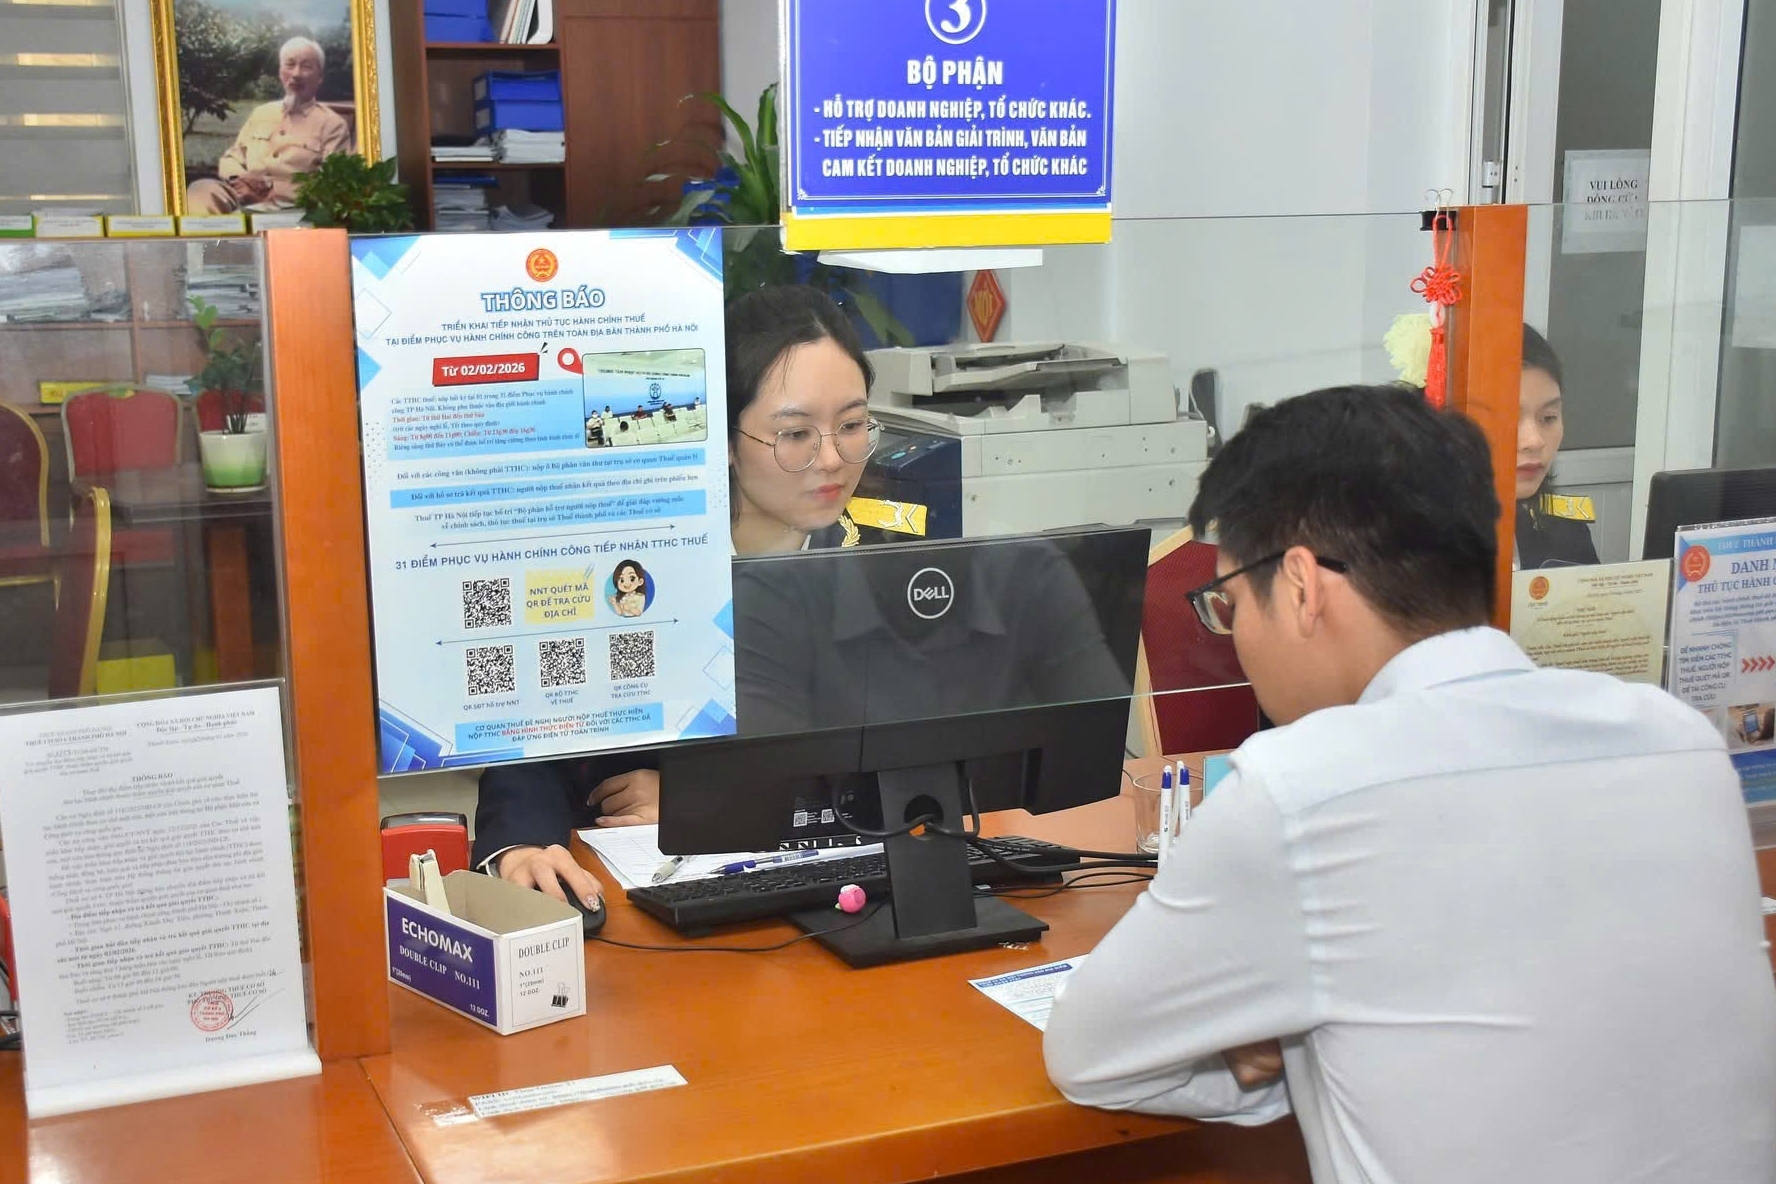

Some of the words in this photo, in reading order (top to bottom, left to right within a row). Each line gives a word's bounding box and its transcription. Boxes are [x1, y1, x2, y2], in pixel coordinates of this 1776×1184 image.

[940, 0, 971, 33] 3
[907, 56, 936, 89] BỘ
[942, 56, 1003, 90] PHẬN
[823, 94, 843, 118] HỖ
[846, 98, 874, 122] TRỢ
[877, 100, 926, 118] DOANH
[929, 97, 985, 122] NGHIỆP,
[988, 94, 1006, 118] TỔ
[1009, 97, 1045, 118] CHỨC
[1049, 98, 1092, 118] KHÁC.
[823, 124, 852, 148] TIẾP
[856, 126, 893, 150] NHẬN
[896, 126, 921, 147] VĂN
[926, 125, 951, 147] BẢN
[955, 125, 982, 147] GIẢI
[985, 126, 1028, 149] TRÌNH,
[1031, 126, 1056, 147] VĂN
[1060, 125, 1086, 147] BẢN
[822, 159, 854, 177] CAM
[857, 153, 882, 176] KẾT
[886, 158, 933, 176] DOANH
[936, 155, 989, 180] NGHIỆP,
[992, 152, 1010, 176] TỔ
[1012, 154, 1048, 176] CHỨC
[1052, 154, 1087, 175] KHÁC
[1590, 181, 1606, 190] VUI
[1610, 177, 1637, 189] LÒNG
[480, 287, 557, 313] THÔNG
[561, 285, 606, 309] BÁO
[442, 320, 466, 331] TRIỂN
[469, 322, 488, 330] KHAI
[490, 318, 508, 329] TIẾP
[511, 318, 533, 329] NHẬN
[535, 317, 552, 327] THỦ
[555, 318, 570, 327] TỤC
[572, 315, 595, 325] HÀNH
[597, 313, 622, 324] CHÍNH
[624, 312, 645, 322] THUẾ
[386, 337, 399, 347] TẠI
[401, 334, 422, 344] ĐIỂM
[424, 335, 448, 345] PHỤC
[450, 335, 461, 344] VỤ
[464, 331, 486, 342] HÀNH
[489, 330, 514, 340] CHÍNH
[516, 329, 540, 339] CÔNG
[543, 328, 564, 338] TRÊN
[566, 327, 588, 337] TOÀN
[590, 328, 602, 337] ĐỊA
[606, 325, 622, 335] BÀN
[624, 324, 650, 334] THÀNH
[653, 323, 670, 333] PHỐ
[672, 323, 682, 332] HÀ
[684, 322, 698, 333] NỘI
[442, 364, 459, 377] Từ
[461, 362, 526, 376] 02/02/2026
[410, 554, 437, 568] ĐIỂM
[441, 555, 470, 567] PHỤC
[474, 553, 488, 564] VỤ
[492, 548, 521, 561] HÀNH
[524, 545, 557, 558] CHÍNH
[560, 542, 590, 556] CÔNG
[593, 540, 616, 553] TIẾP
[620, 538, 648, 553] NHẬN
[651, 538, 677, 548] TTHC
[680, 532, 708, 546] THUẾ
[1731, 558, 1769, 574] DANH
[530, 587, 548, 595] NNT
[550, 584, 572, 594] QUÉT
[575, 582, 589, 591] MÃ
[914, 586, 949, 601] DELL
[1698, 580, 1717, 593] THỦ
[1721, 580, 1740, 593] TỤC
[1742, 576, 1770, 589] HÀNH
[526, 600, 538, 608] QR
[541, 597, 552, 606] ĐỂ
[572, 594, 591, 604] CỨU
[544, 610, 560, 619] ĐỊA
[562, 607, 576, 616] CHỈ
[402, 917, 473, 963] ECHOMAX
[518, 941, 550, 959] DOUBLE
[552, 937, 570, 951] CLIP
[400, 945, 428, 966] DOUBLE
[429, 959, 447, 974] CLIP
[455, 970, 480, 990] NO.111
[520, 967, 543, 978] NO.111
[470, 1003, 476, 1012] 12
[477, 1007, 490, 1017] DOZ.
